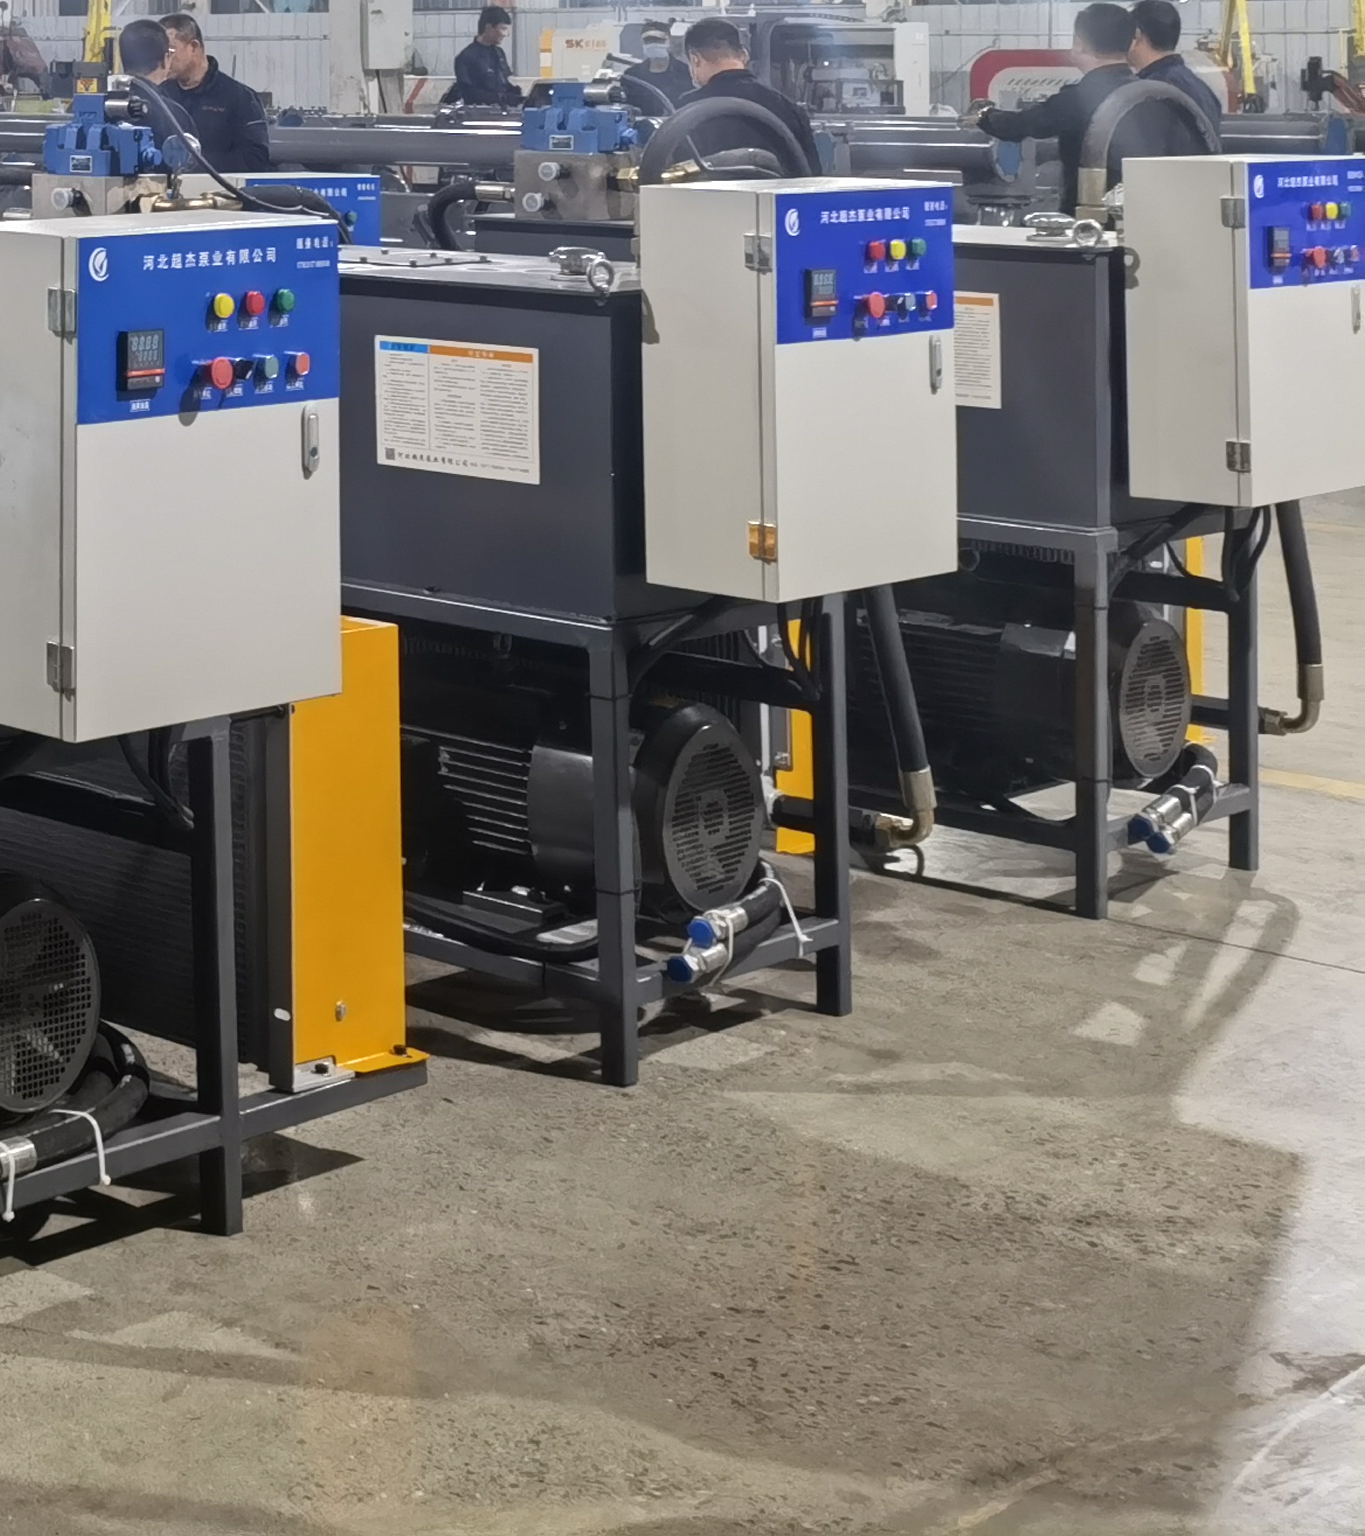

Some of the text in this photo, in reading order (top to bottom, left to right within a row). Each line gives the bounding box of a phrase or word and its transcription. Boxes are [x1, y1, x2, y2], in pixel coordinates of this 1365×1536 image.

[143, 246, 276, 271] 河北超杰泵业有限公司
